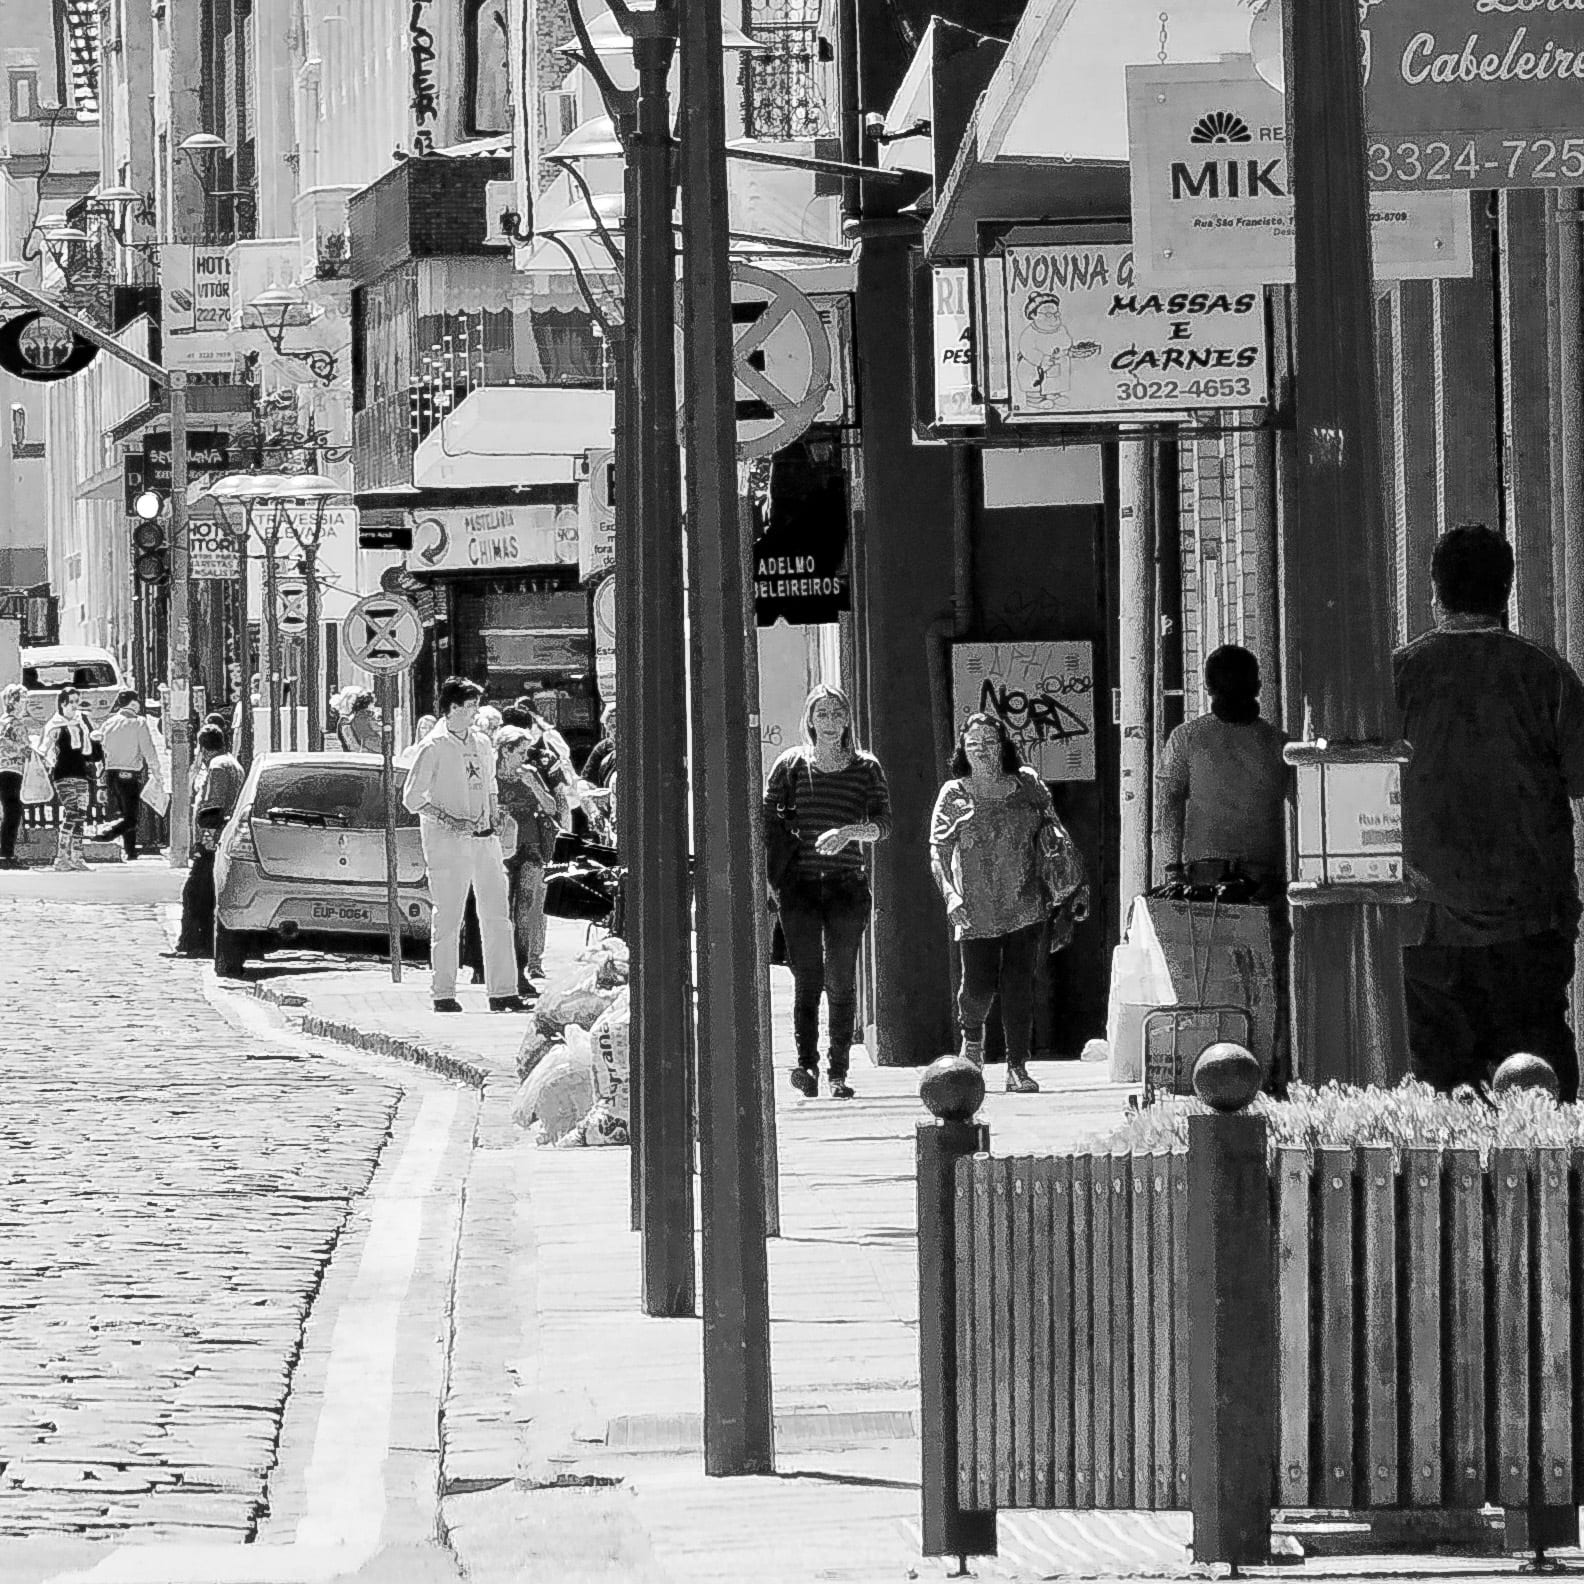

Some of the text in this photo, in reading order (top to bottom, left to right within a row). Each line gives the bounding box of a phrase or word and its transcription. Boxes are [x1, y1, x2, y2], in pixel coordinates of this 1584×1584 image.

[1260, 127, 1284, 142] RE
[1171, 159, 1287, 200] MIK
[1193, 218, 1214, 228] Rua
[1011, 253, 1109, 294] NONNA
[936, 277, 966, 315] RI
[1108, 292, 1256, 316] MASSAS
[1168, 320, 1193, 341] E
[1110, 345, 1259, 372] CARNES
[1116, 377, 1252, 402] 3022-4653
[468, 535, 519, 565] CHIMAS
[758, 555, 815, 576] ADELMO
